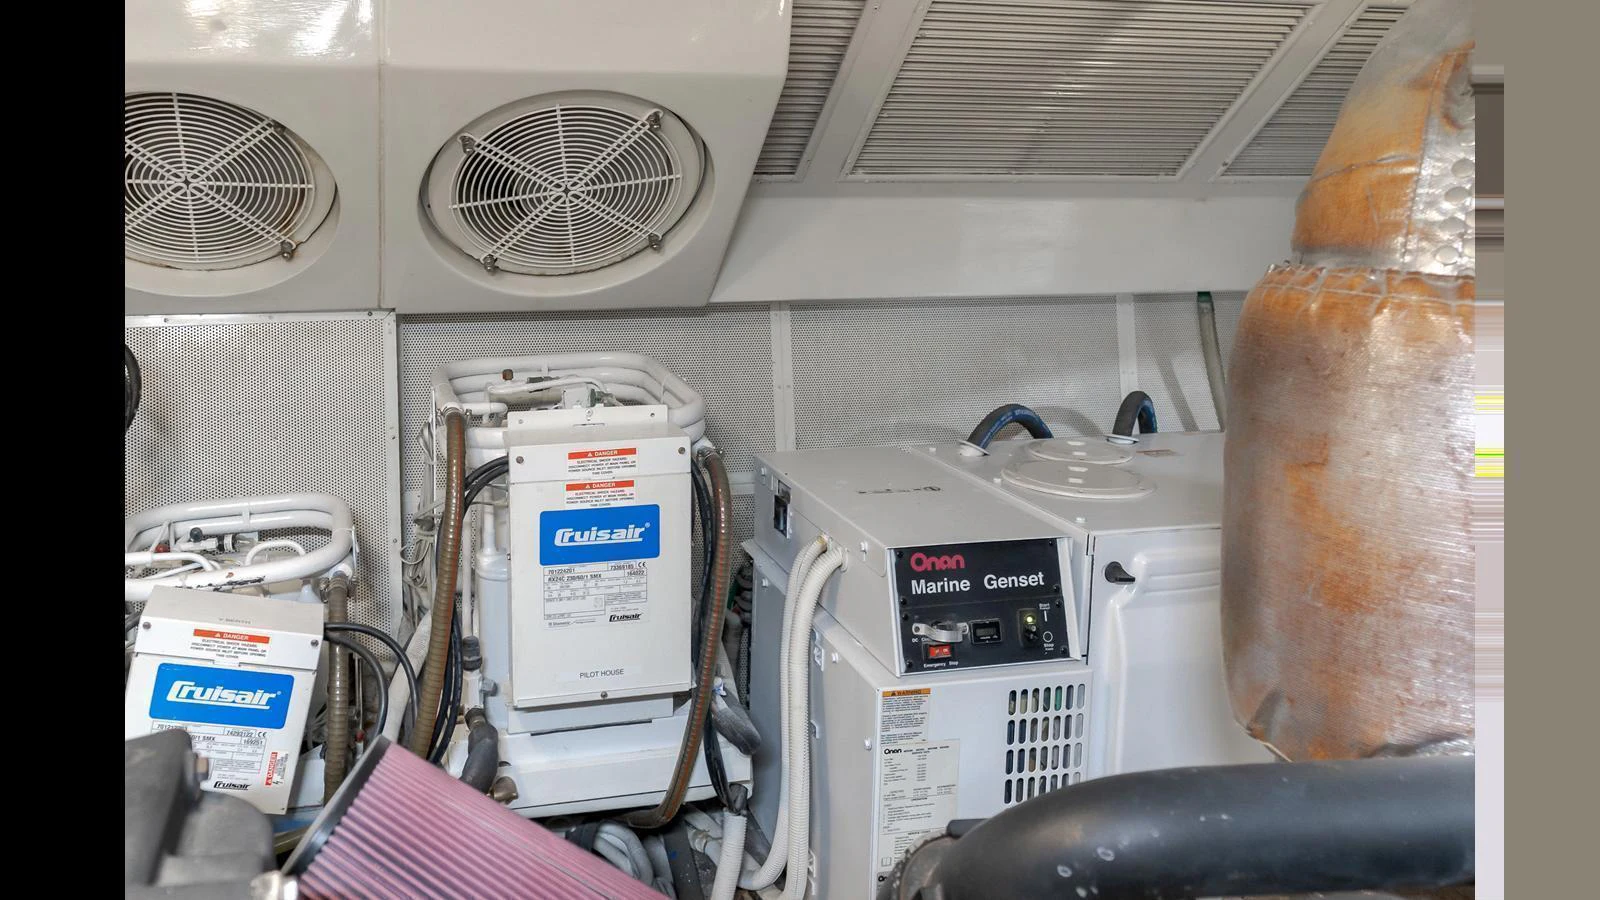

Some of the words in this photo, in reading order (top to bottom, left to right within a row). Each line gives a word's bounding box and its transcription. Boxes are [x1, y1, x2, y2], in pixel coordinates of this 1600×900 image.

[554, 524, 646, 547] Cruisair
[910, 552, 965, 572] Onan
[911, 578, 970, 595] Marine
[984, 572, 1044, 589] Genset
[609, 614, 641, 622] Cruisair
[580, 670, 599, 678] PILOT
[166, 680, 276, 710] Cruisair
[267, 752, 278, 778] DANGER
[214, 781, 252, 790] Cruisair
